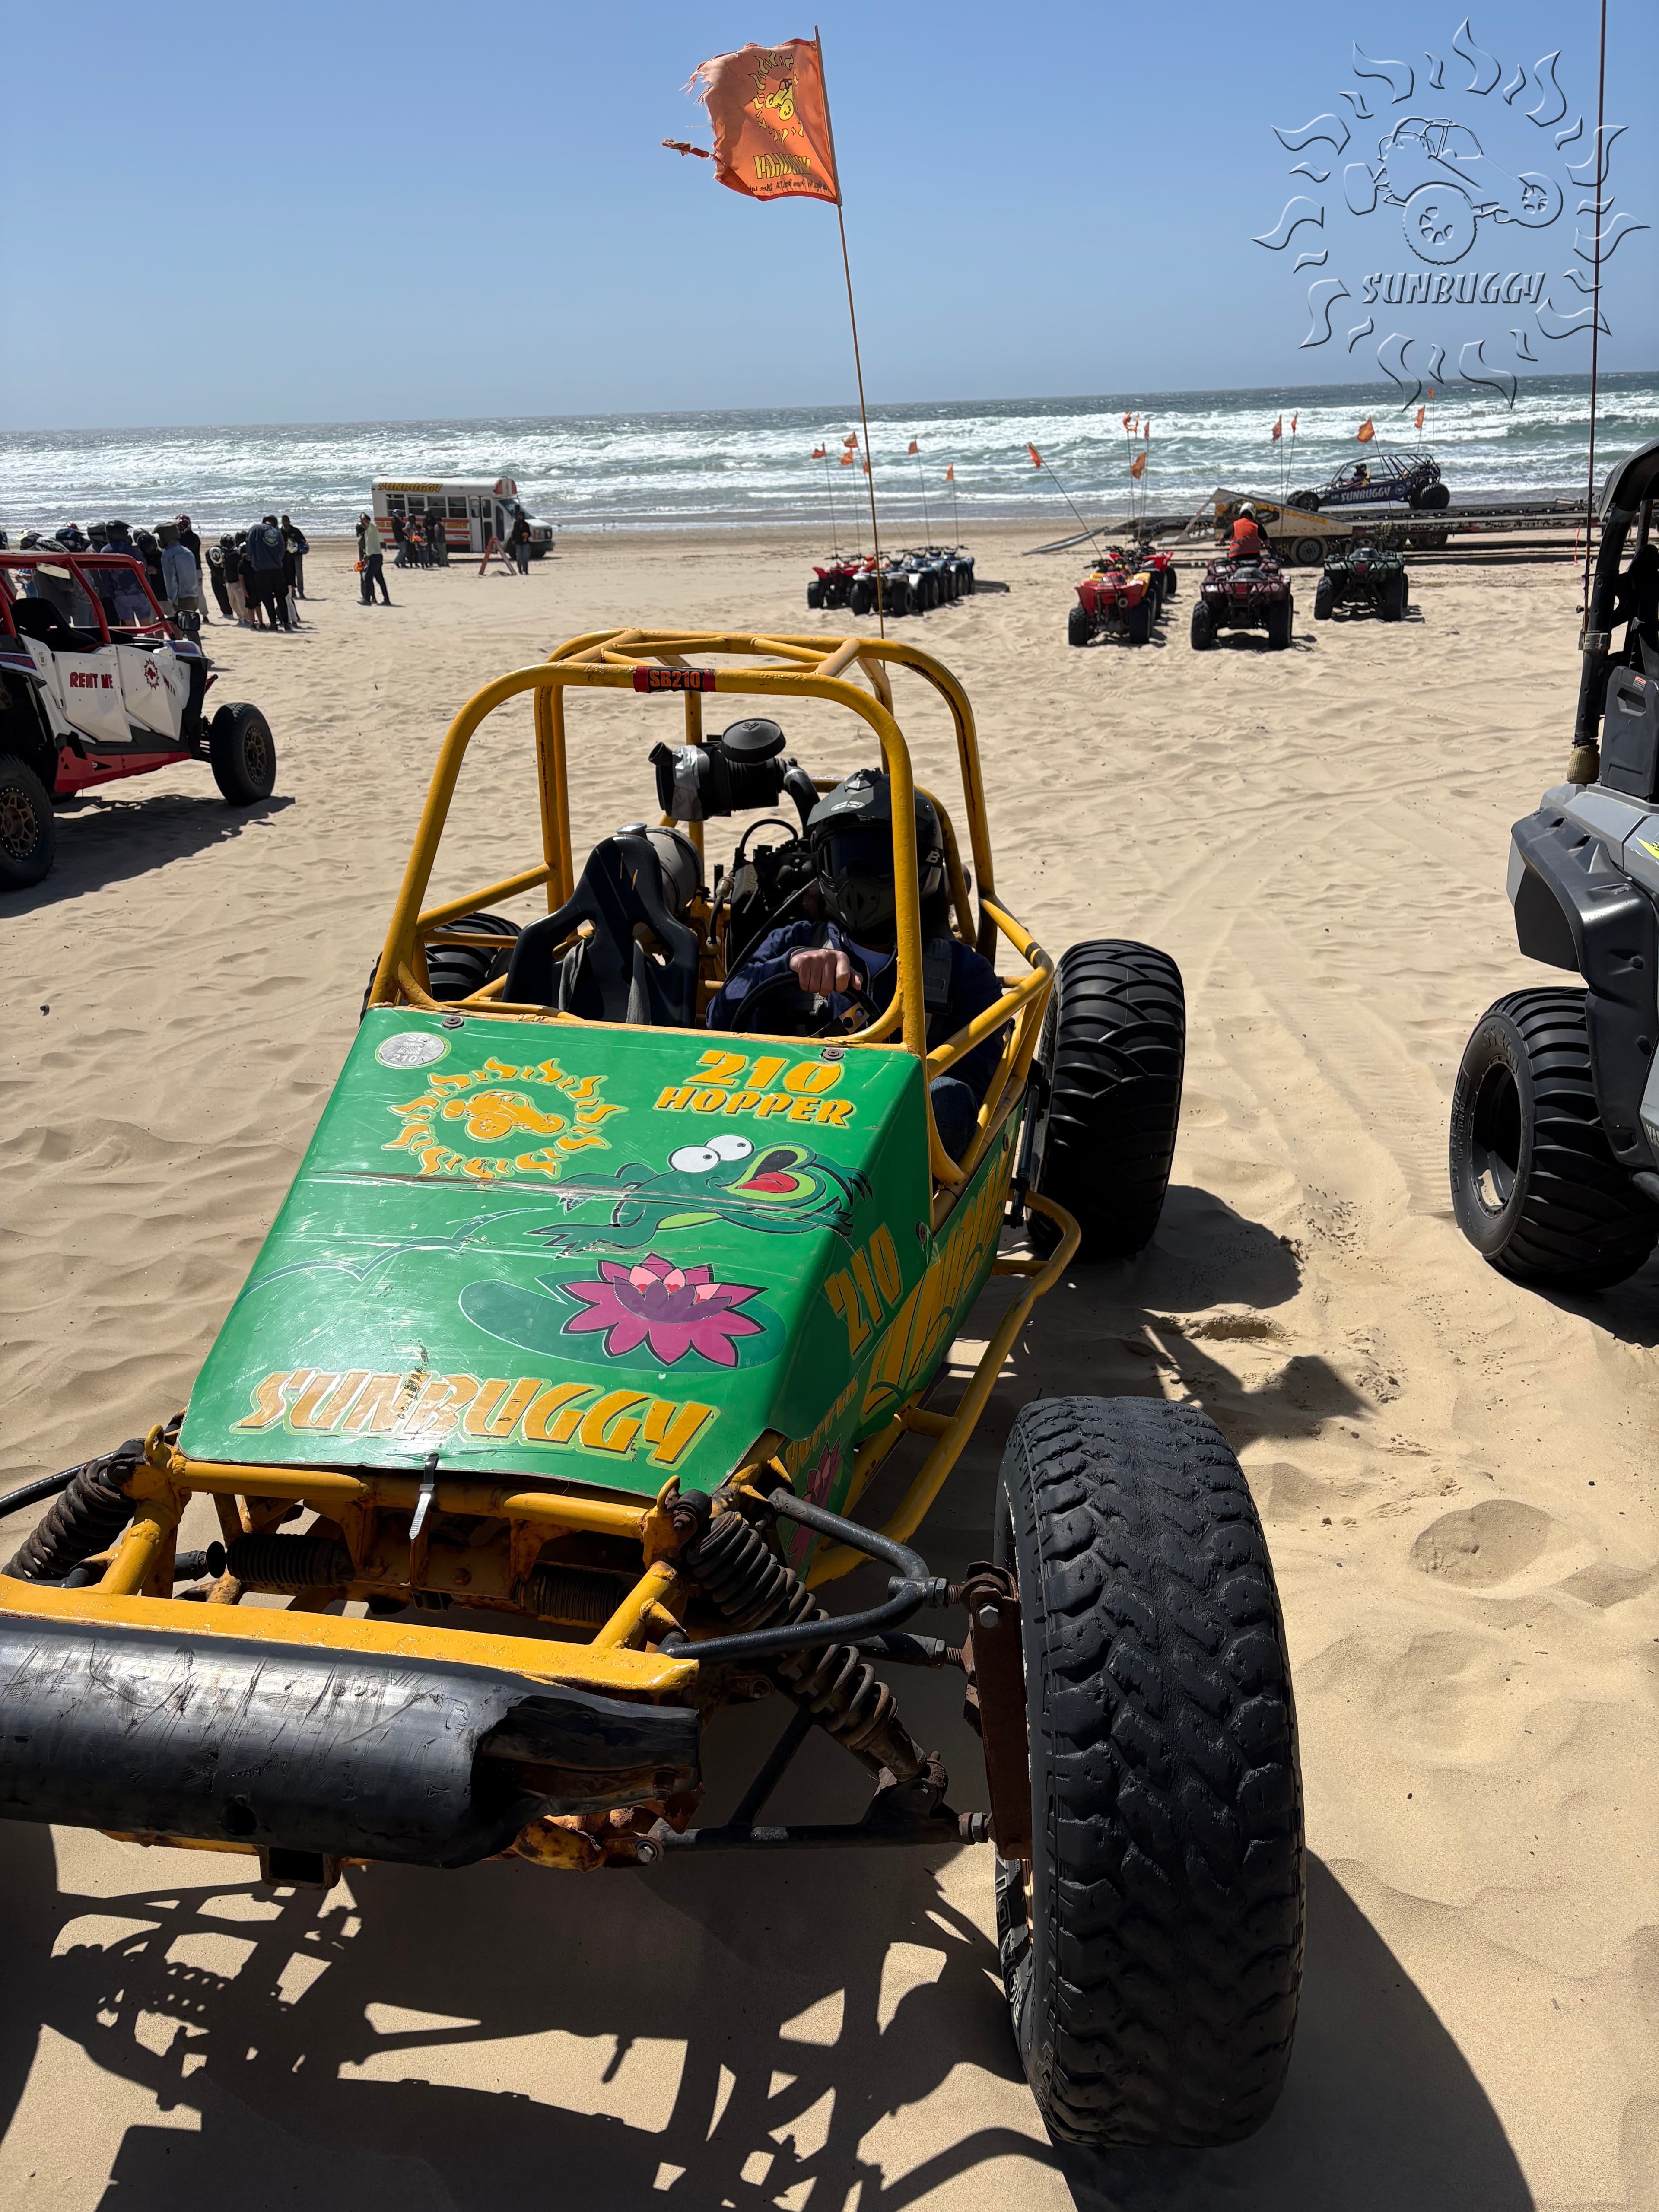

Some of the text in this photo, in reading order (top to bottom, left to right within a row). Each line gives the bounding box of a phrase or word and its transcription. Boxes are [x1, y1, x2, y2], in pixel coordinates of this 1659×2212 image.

[378, 483, 443, 492] SUNBUGGY
[1341, 486, 1391, 502] SUNBUGGY
[70, 671, 114, 689] RENT ME
[649, 670, 700, 688] SB210
[390, 1053, 417, 1062] 210
[684, 1050, 843, 1094] 210
[655, 1086, 855, 1127] HOPPER
[824, 1223, 902, 1357] 210
[237, 1370, 715, 1463] SUNBUGGY
